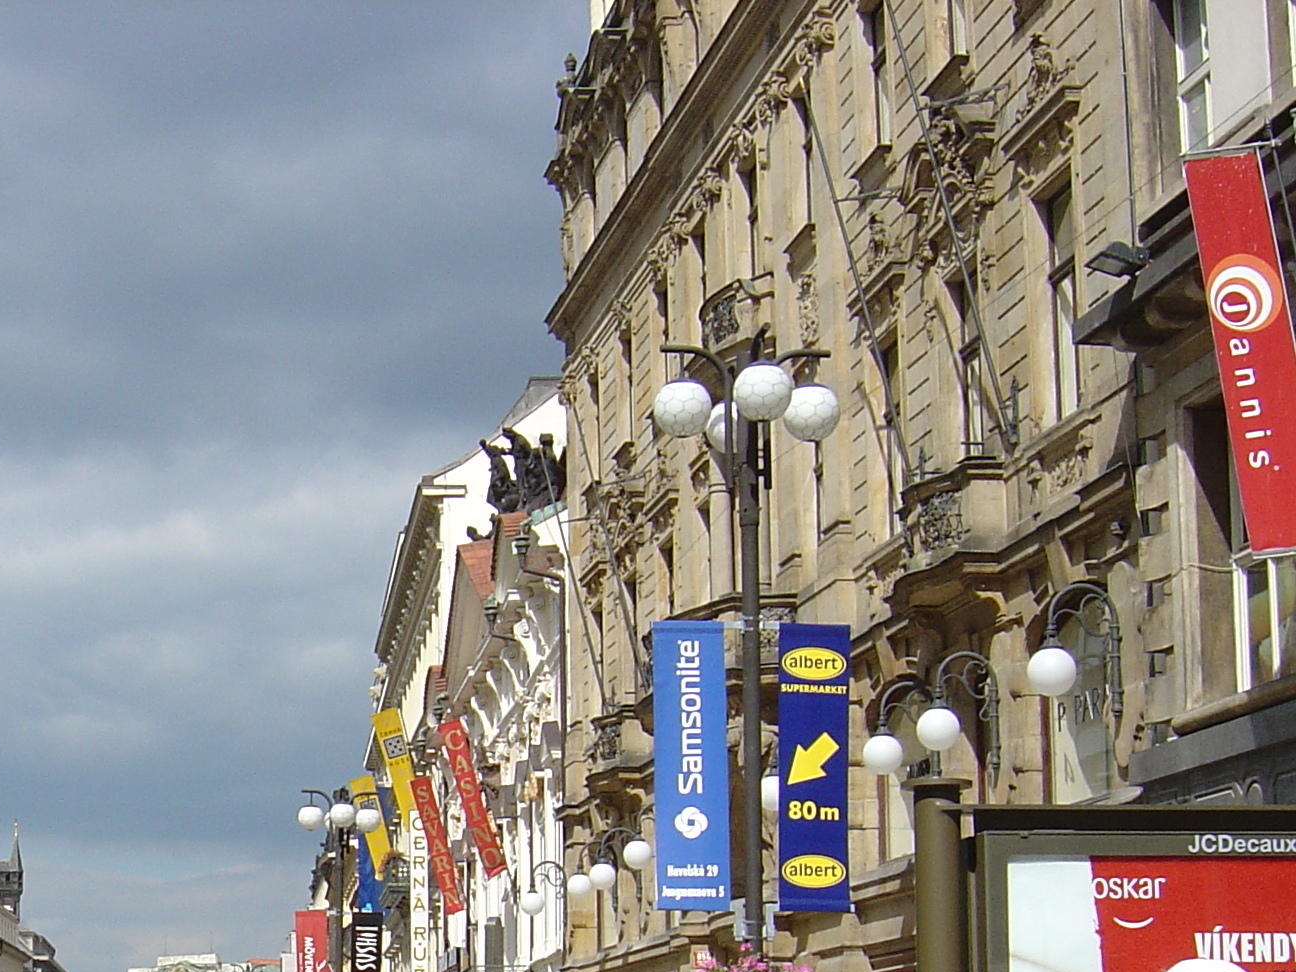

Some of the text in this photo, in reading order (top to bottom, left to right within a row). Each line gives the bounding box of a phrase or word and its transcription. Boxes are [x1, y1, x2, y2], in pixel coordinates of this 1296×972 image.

[789, 652, 839, 671] albert
[781, 683, 847, 695] SUPERMARKET
[677, 639, 703, 795] Samsonite
[444, 730, 503, 869] CASINO
[788, 800, 840, 821] 80 m
[416, 785, 461, 908] SAVARIN
[1188, 834, 1296, 853] JCDecaux
[412, 812, 426, 912] ČERNÁ
[706, 865, 719, 877] 29
[789, 861, 838, 878] albert
[718, 886, 725, 899] 5
